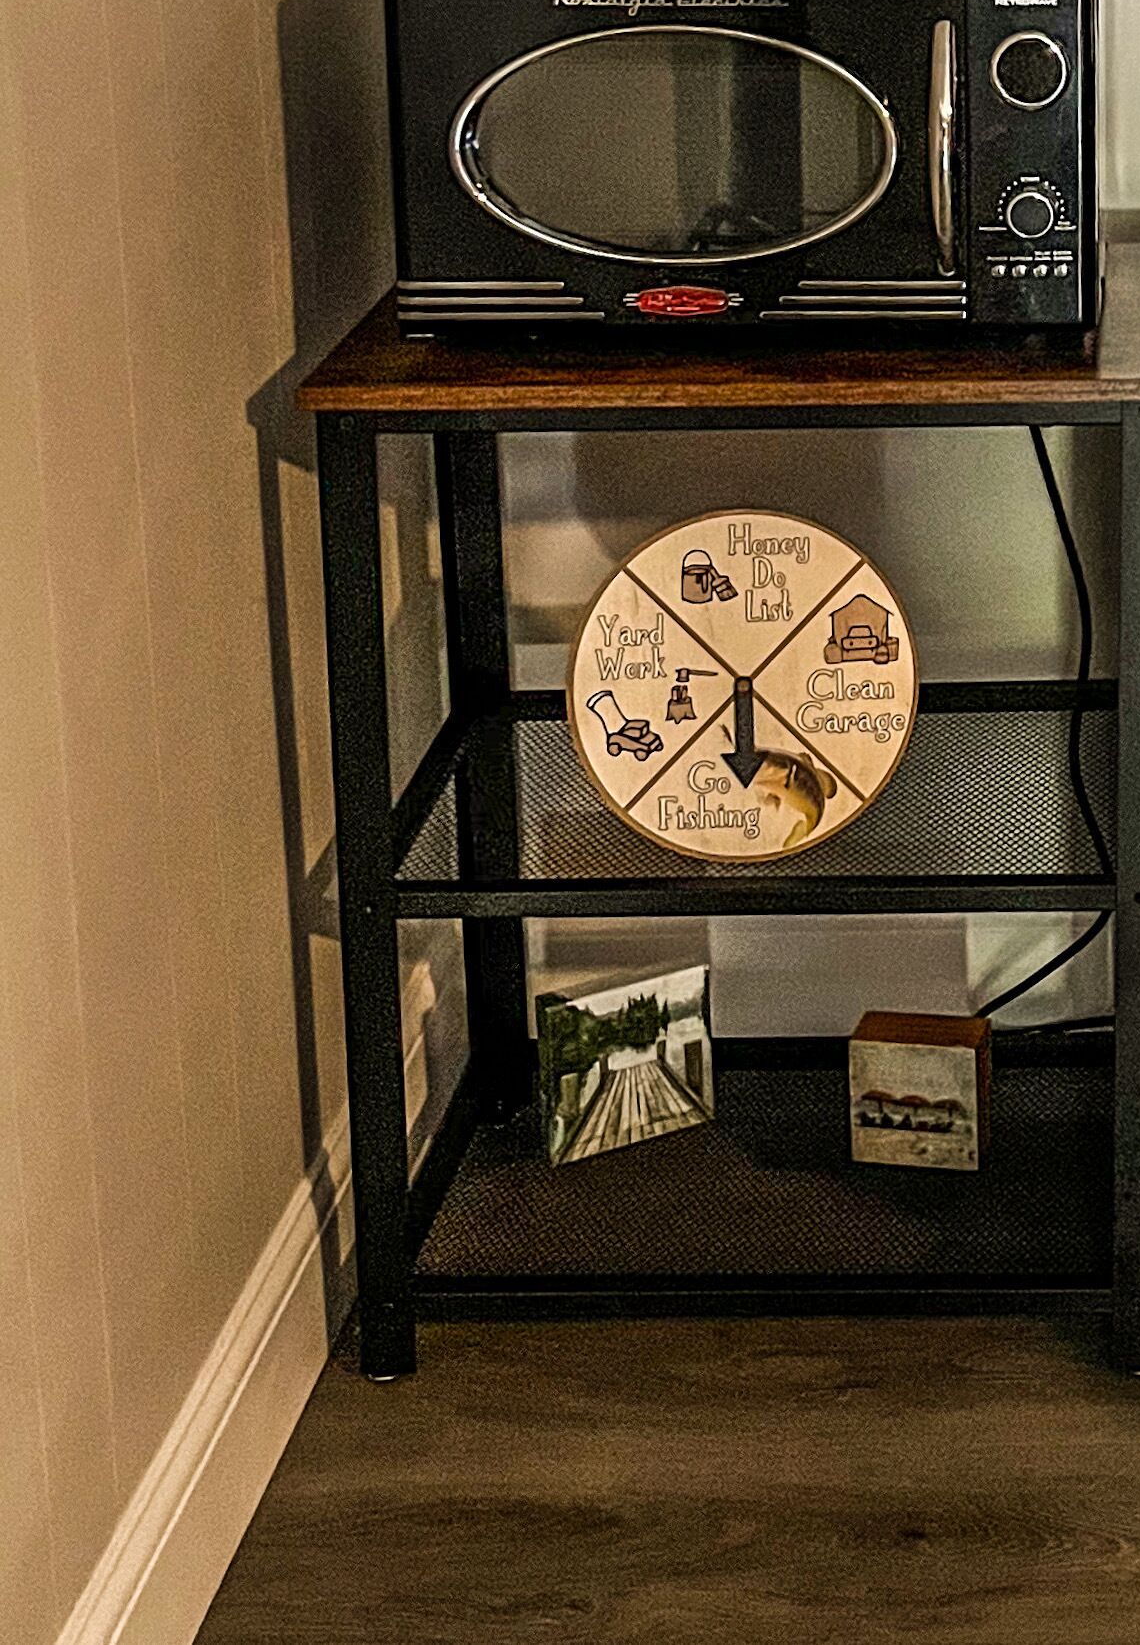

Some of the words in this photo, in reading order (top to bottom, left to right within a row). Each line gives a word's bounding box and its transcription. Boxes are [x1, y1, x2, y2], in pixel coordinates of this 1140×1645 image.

[728, 523, 810, 564] Honey
[752, 556, 786, 588] Do
[745, 588, 793, 622] List
[598, 614, 664, 646] Yard
[595, 647, 667, 680] Work
[806, 668, 895, 702] Clean
[796, 701, 906, 742] Garage
[687, 760, 731, 795] Go
[658, 795, 761, 839] Fishing
